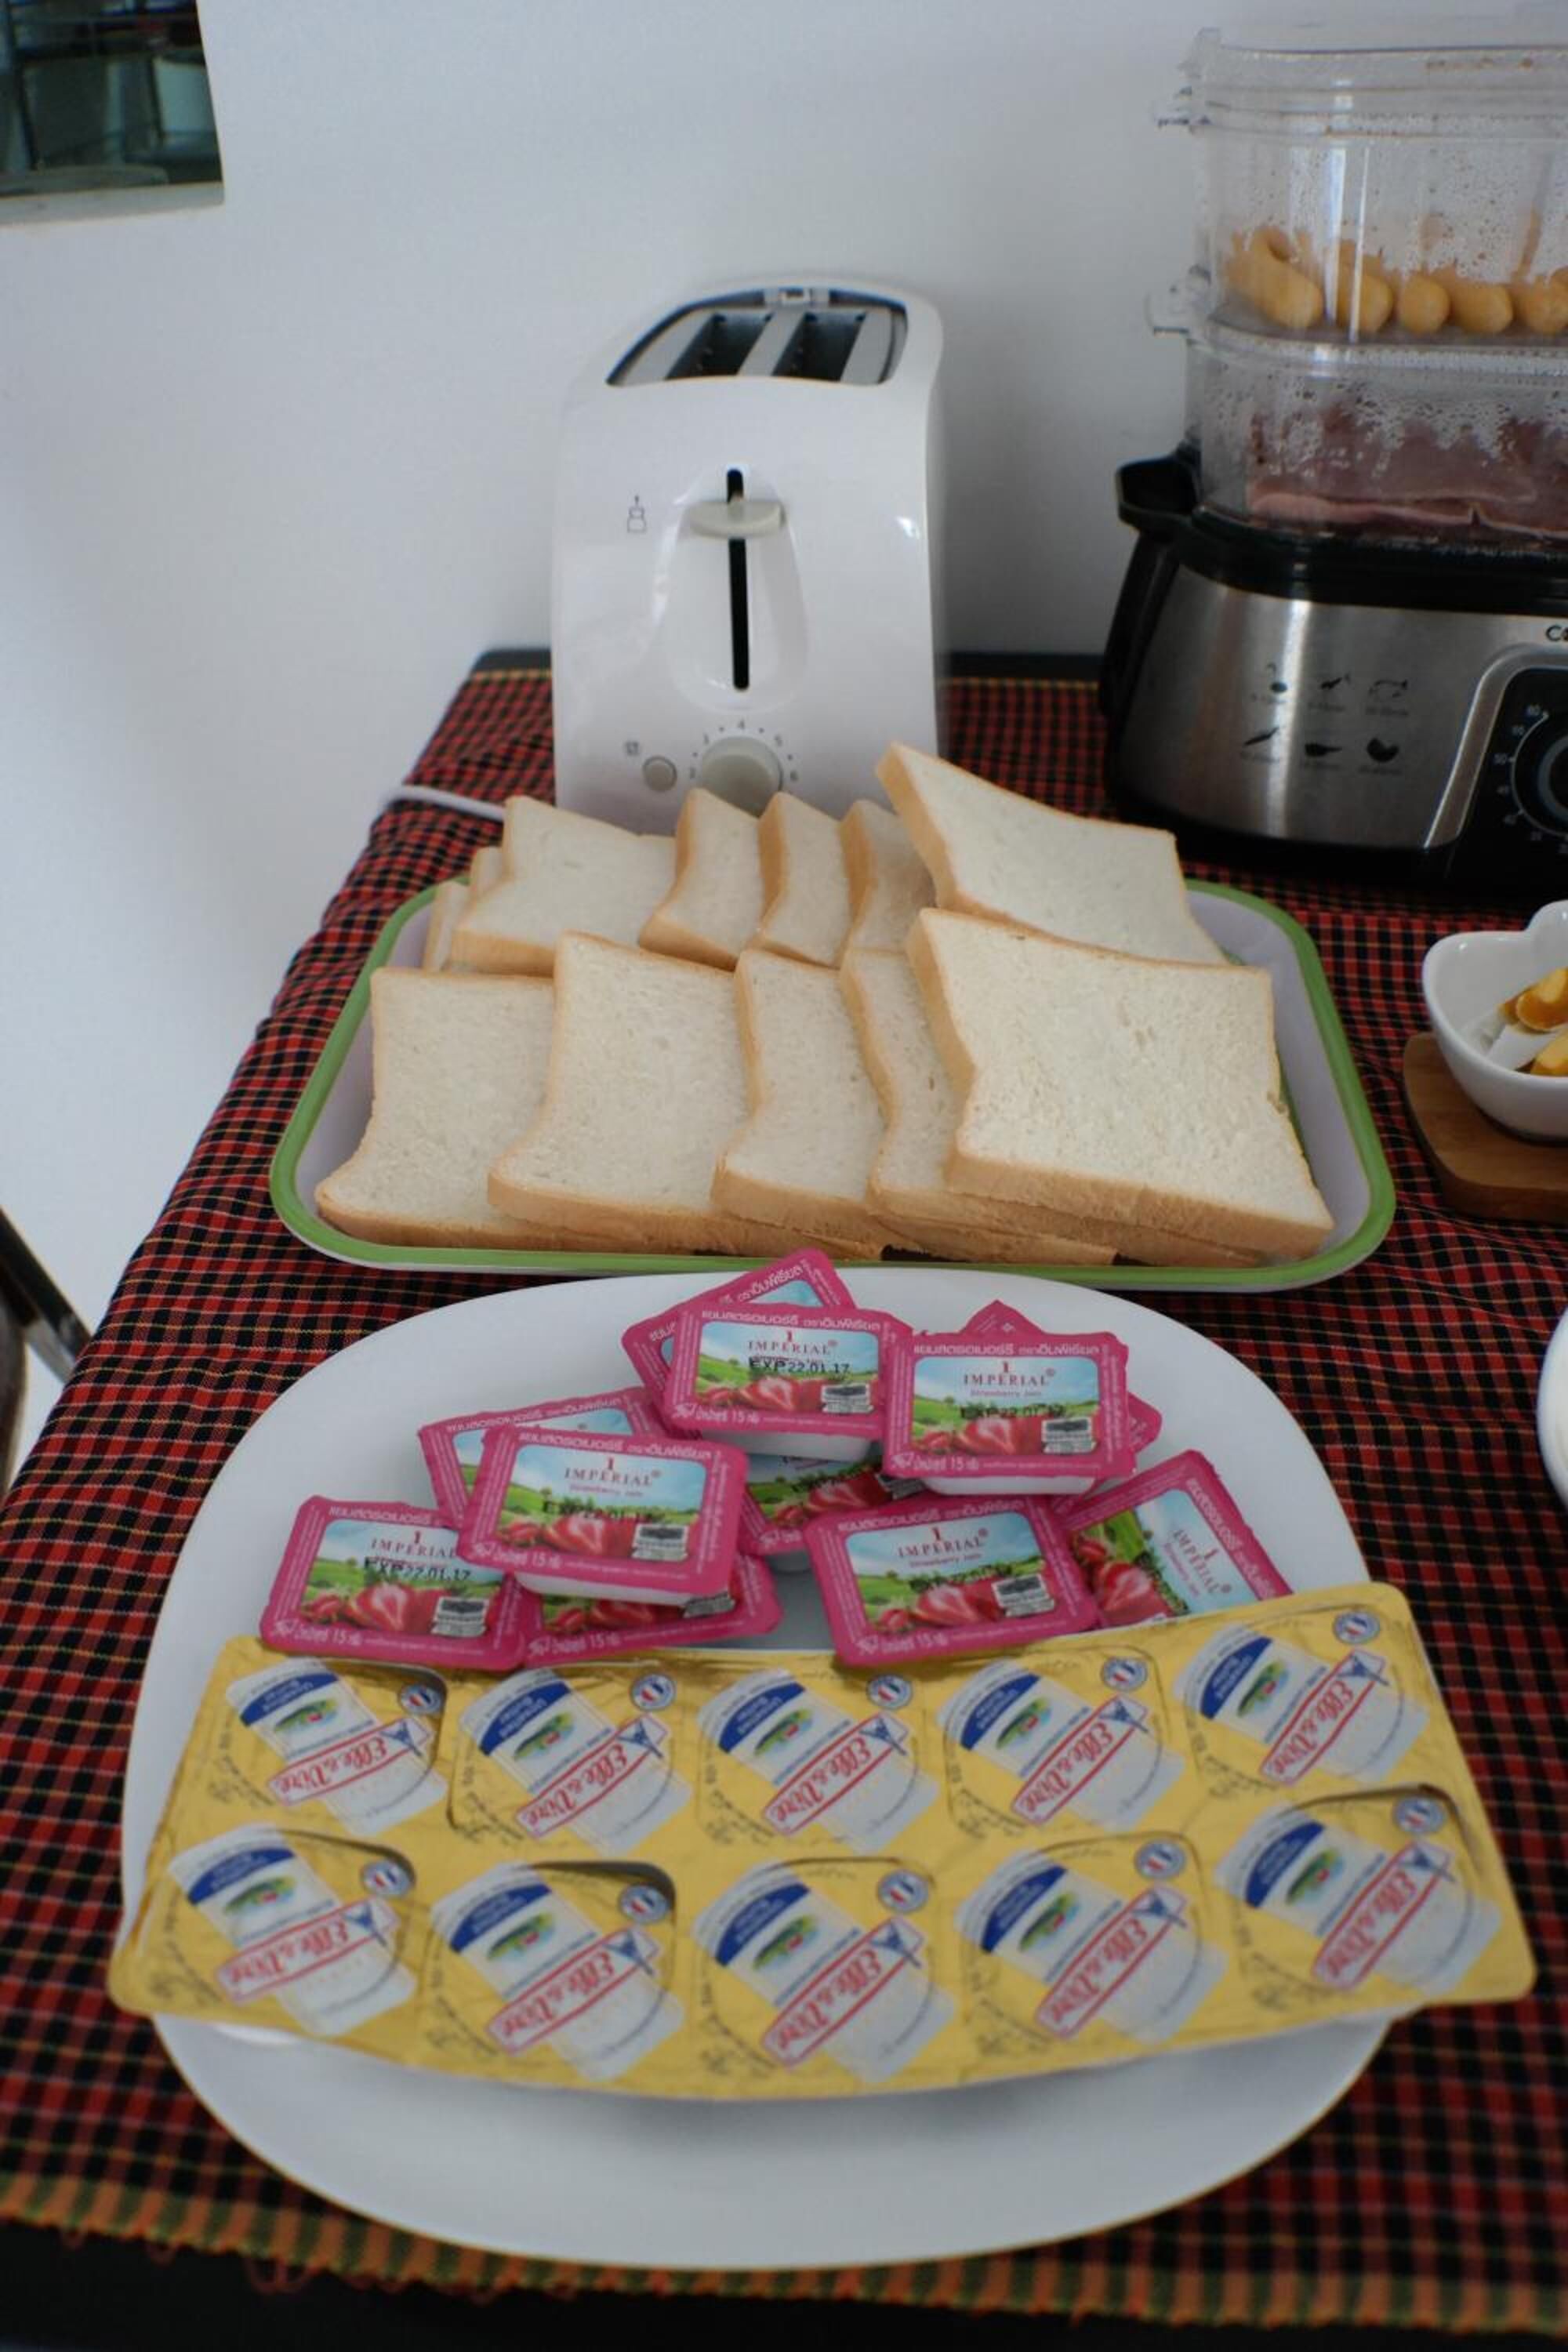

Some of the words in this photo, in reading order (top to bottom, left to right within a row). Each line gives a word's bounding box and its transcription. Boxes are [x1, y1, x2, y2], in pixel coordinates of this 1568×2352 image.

[748, 1339, 831, 1355] IMPERIAL
[748, 1356, 786, 1372] EXP
[964, 1374, 1050, 1386] IMPERIAL
[564, 1468, 652, 1486] IMPERIAL
[364, 1555, 405, 1576] EXP
[898, 1537, 984, 1559] IMPERIAL
[1311, 1679, 1354, 1723] Elle
[342, 1737, 389, 1769] Elle
[825, 1736, 873, 1780] Elle
[1069, 1720, 1115, 1766] Elle
[1267, 1728, 1319, 1781] Vire
[278, 1762, 328, 1795] Vire
[582, 1744, 630, 1787] Elle
[525, 1787, 575, 1835] Vire
[771, 1777, 825, 1830] Vire
[1018, 1767, 1071, 1820] Vire
